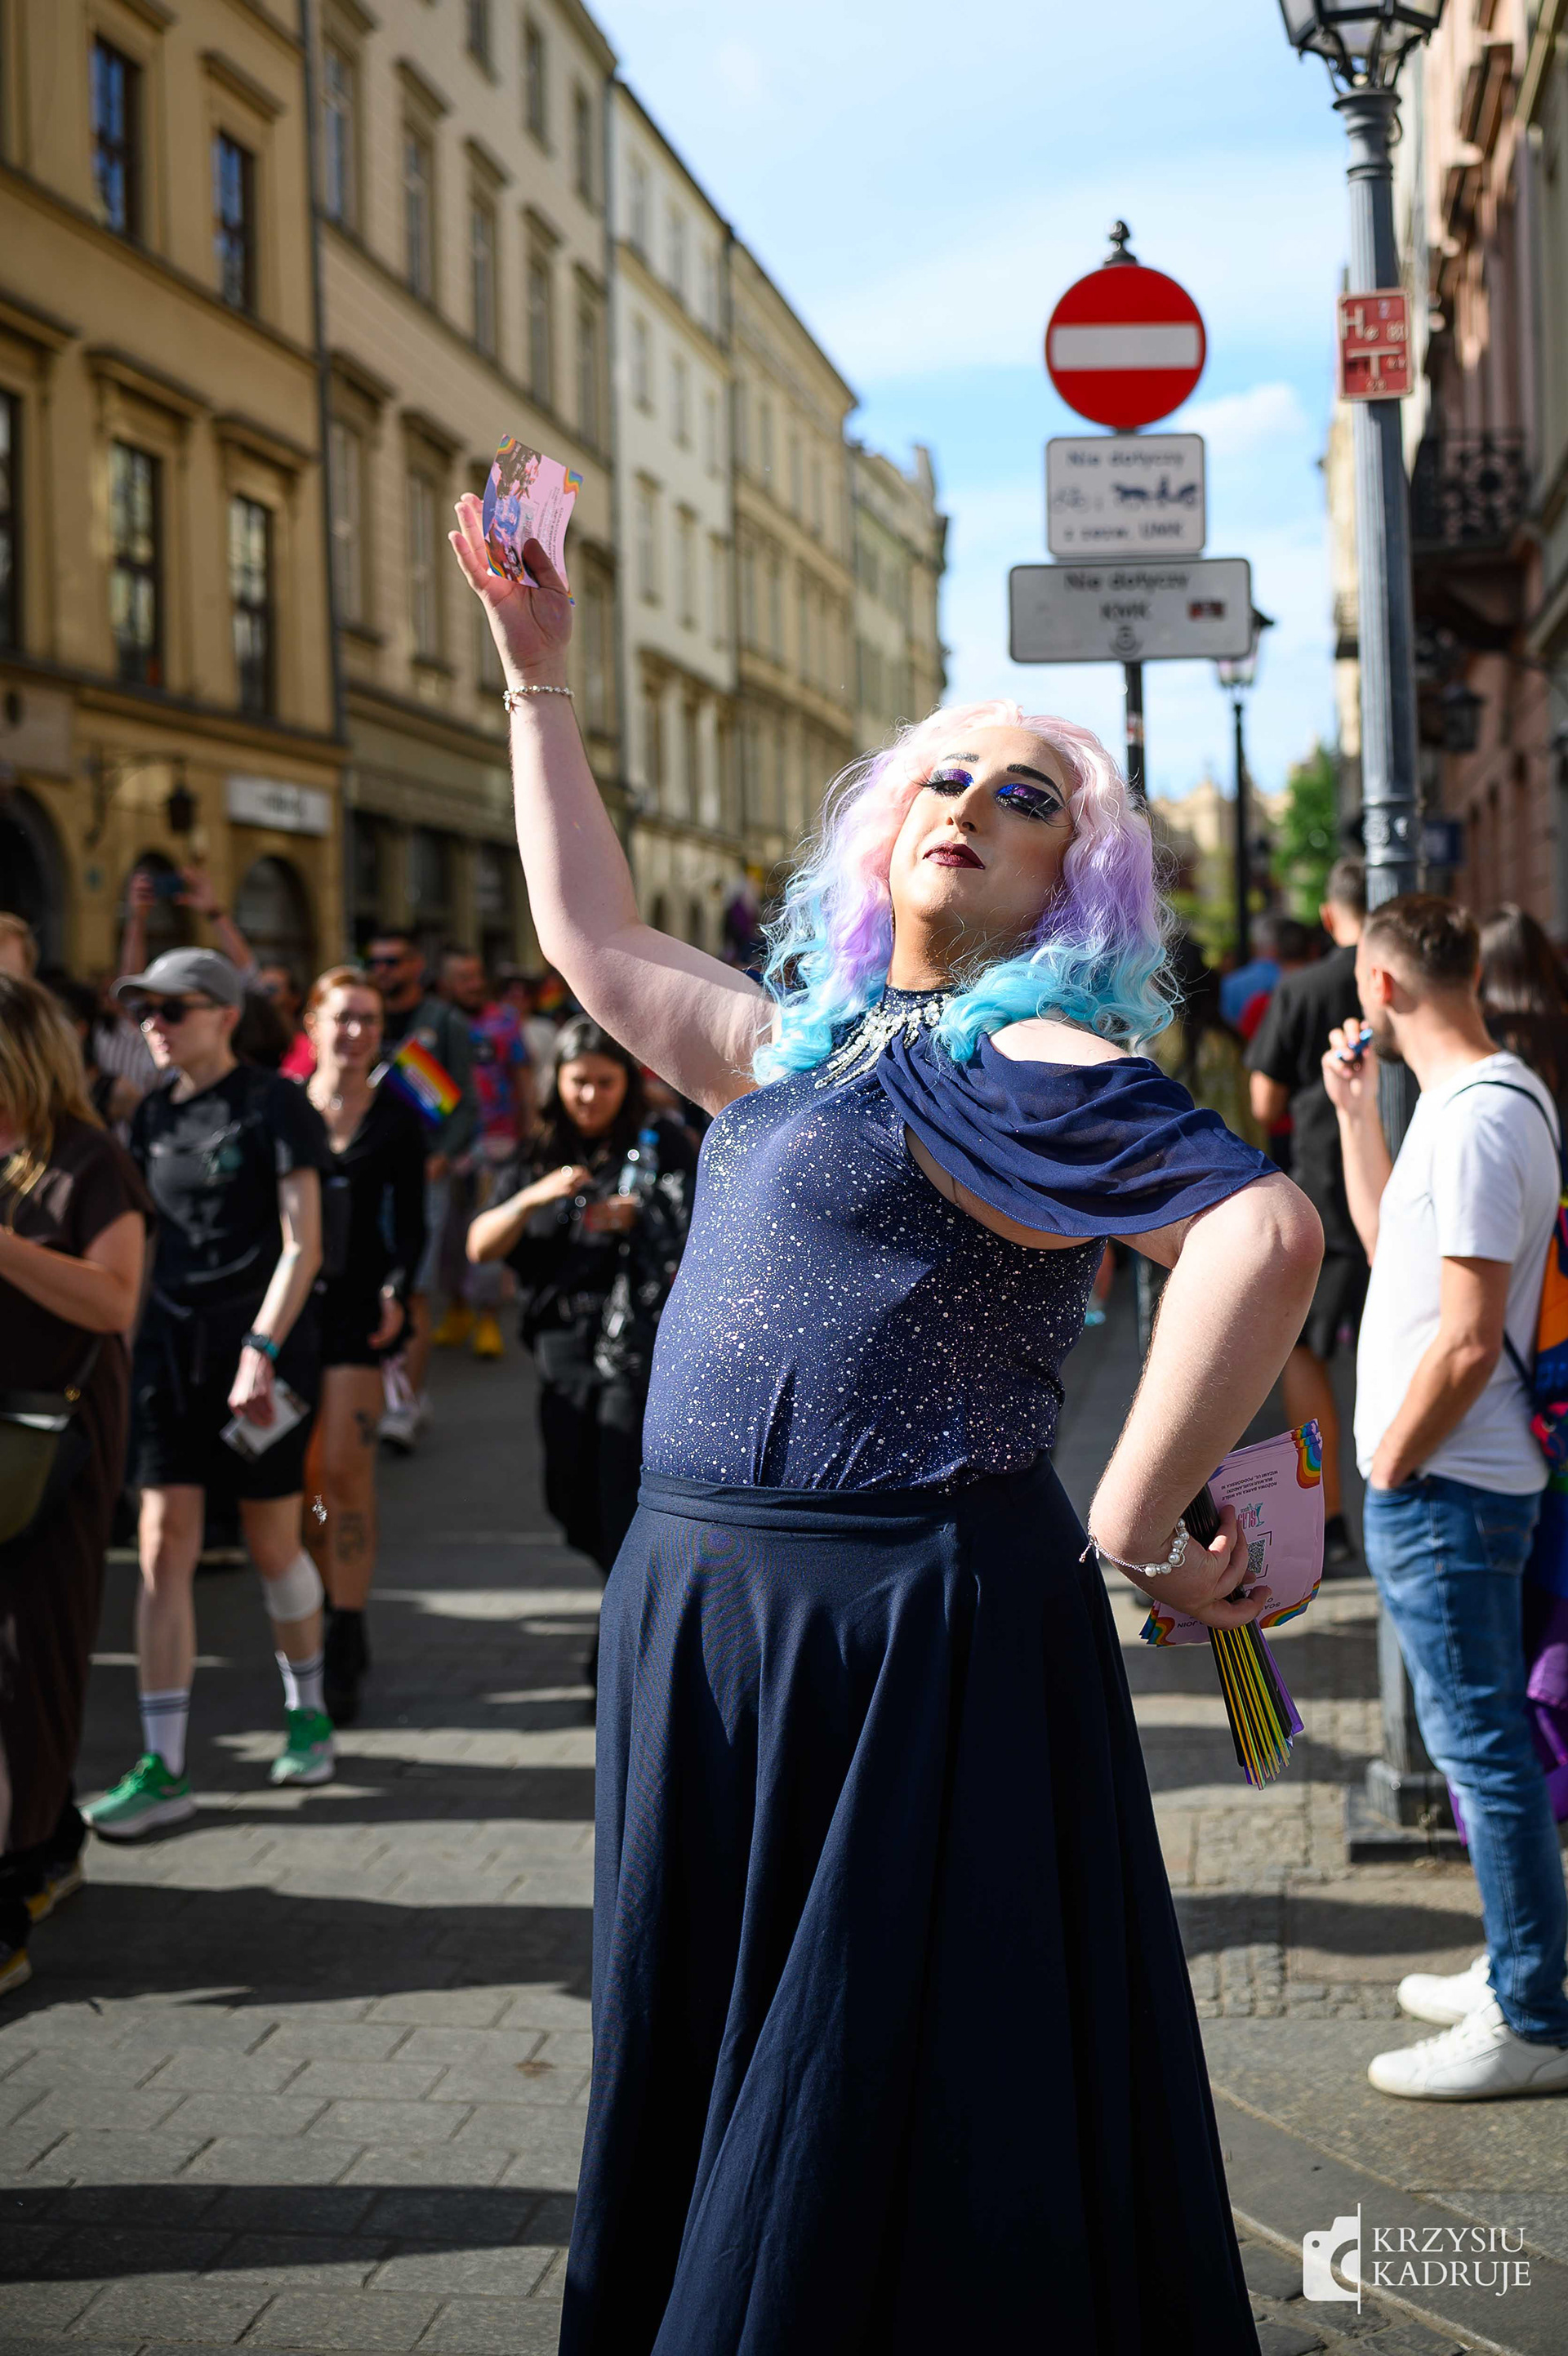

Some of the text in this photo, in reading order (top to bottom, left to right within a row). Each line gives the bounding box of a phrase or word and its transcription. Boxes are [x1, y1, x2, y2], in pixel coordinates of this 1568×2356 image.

[1067, 450, 1184, 470] Nie dotyczy
[1065, 571, 1188, 594] Nie dotyczy
[1263, 1601, 1281, 1611] SCA
[1177, 1619, 1199, 1628] JOIN
